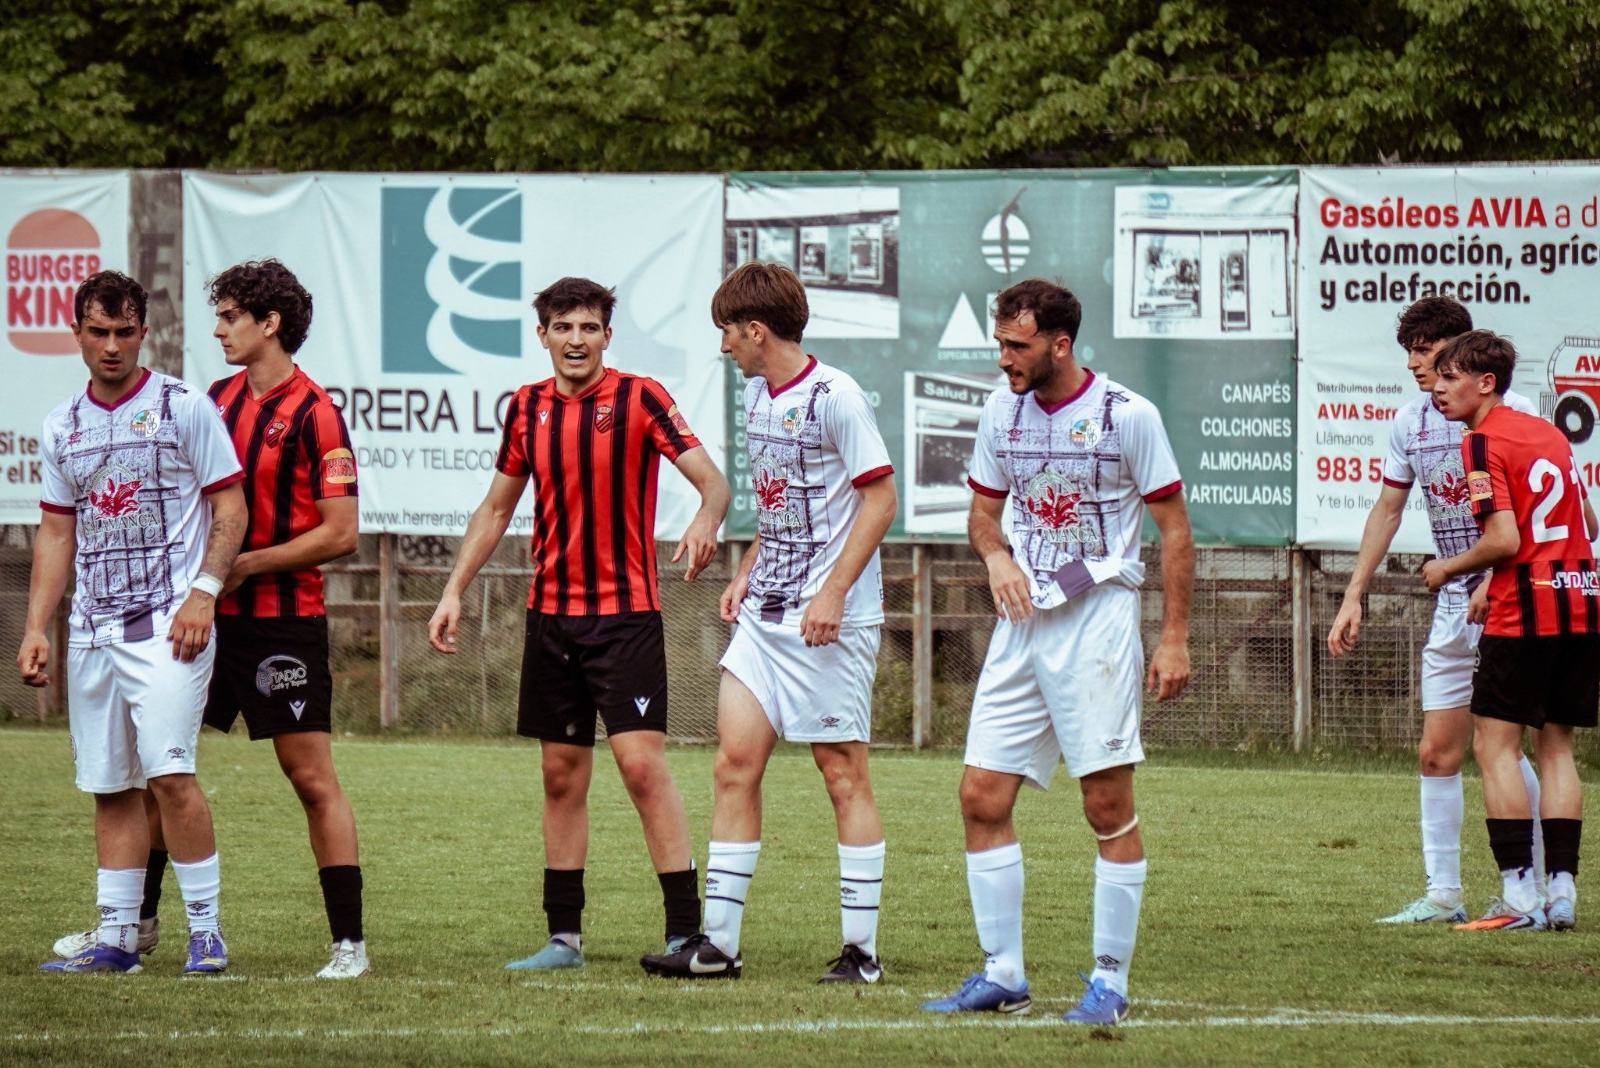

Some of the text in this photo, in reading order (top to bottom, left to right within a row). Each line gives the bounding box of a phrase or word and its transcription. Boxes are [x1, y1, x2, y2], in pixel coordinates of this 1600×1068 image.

[1320, 197, 1459, 228] Gasóleos
[1466, 197, 1547, 228] AVIA
[1555, 204, 1571, 228] a
[1320, 234, 1600, 275] Automoción, agríc
[7, 254, 100, 283] BURGER
[1320, 272, 1530, 310] y calefacción.
[8, 286, 75, 326] KIN
[1575, 355, 1600, 372] AV
[923, 381, 968, 401] Salud
[1222, 380, 1291, 403] CANAPÉS
[1317, 383, 1403, 394] Distribuimos desde
[1318, 403, 1359, 420] AVIA
[1201, 418, 1292, 438] COLCHONES
[19, 435, 39, 455] te
[1316, 432, 1374, 446] Llámanos
[1200, 452, 1292, 472] ALMOHADAS
[1316, 456, 1362, 482] 983
[1190, 485, 1292, 506] ARTICULADAS
